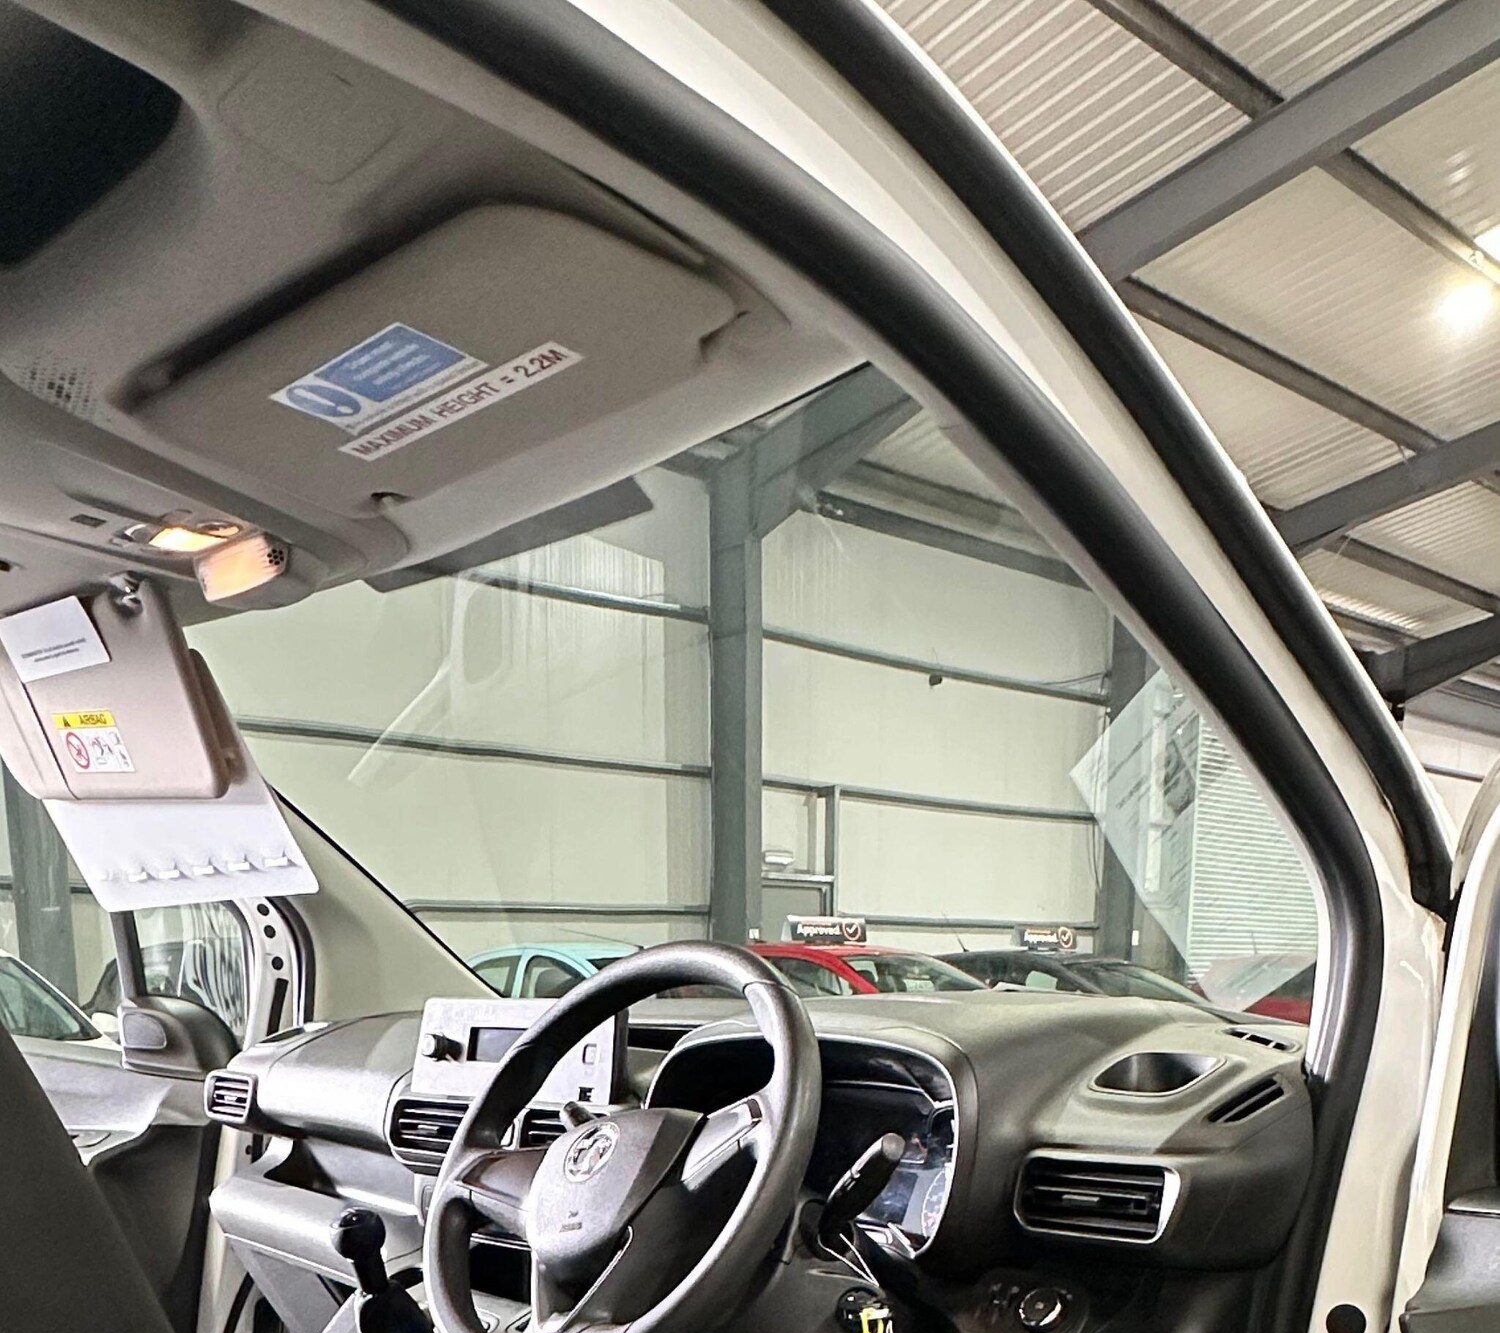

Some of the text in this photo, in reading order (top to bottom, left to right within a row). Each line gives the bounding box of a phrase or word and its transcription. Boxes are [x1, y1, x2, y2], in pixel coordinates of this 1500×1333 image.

[351, 415, 435, 455] MAXIMUM
[433, 382, 499, 418] HEIGHT
[514, 349, 568, 378] 2.2M
